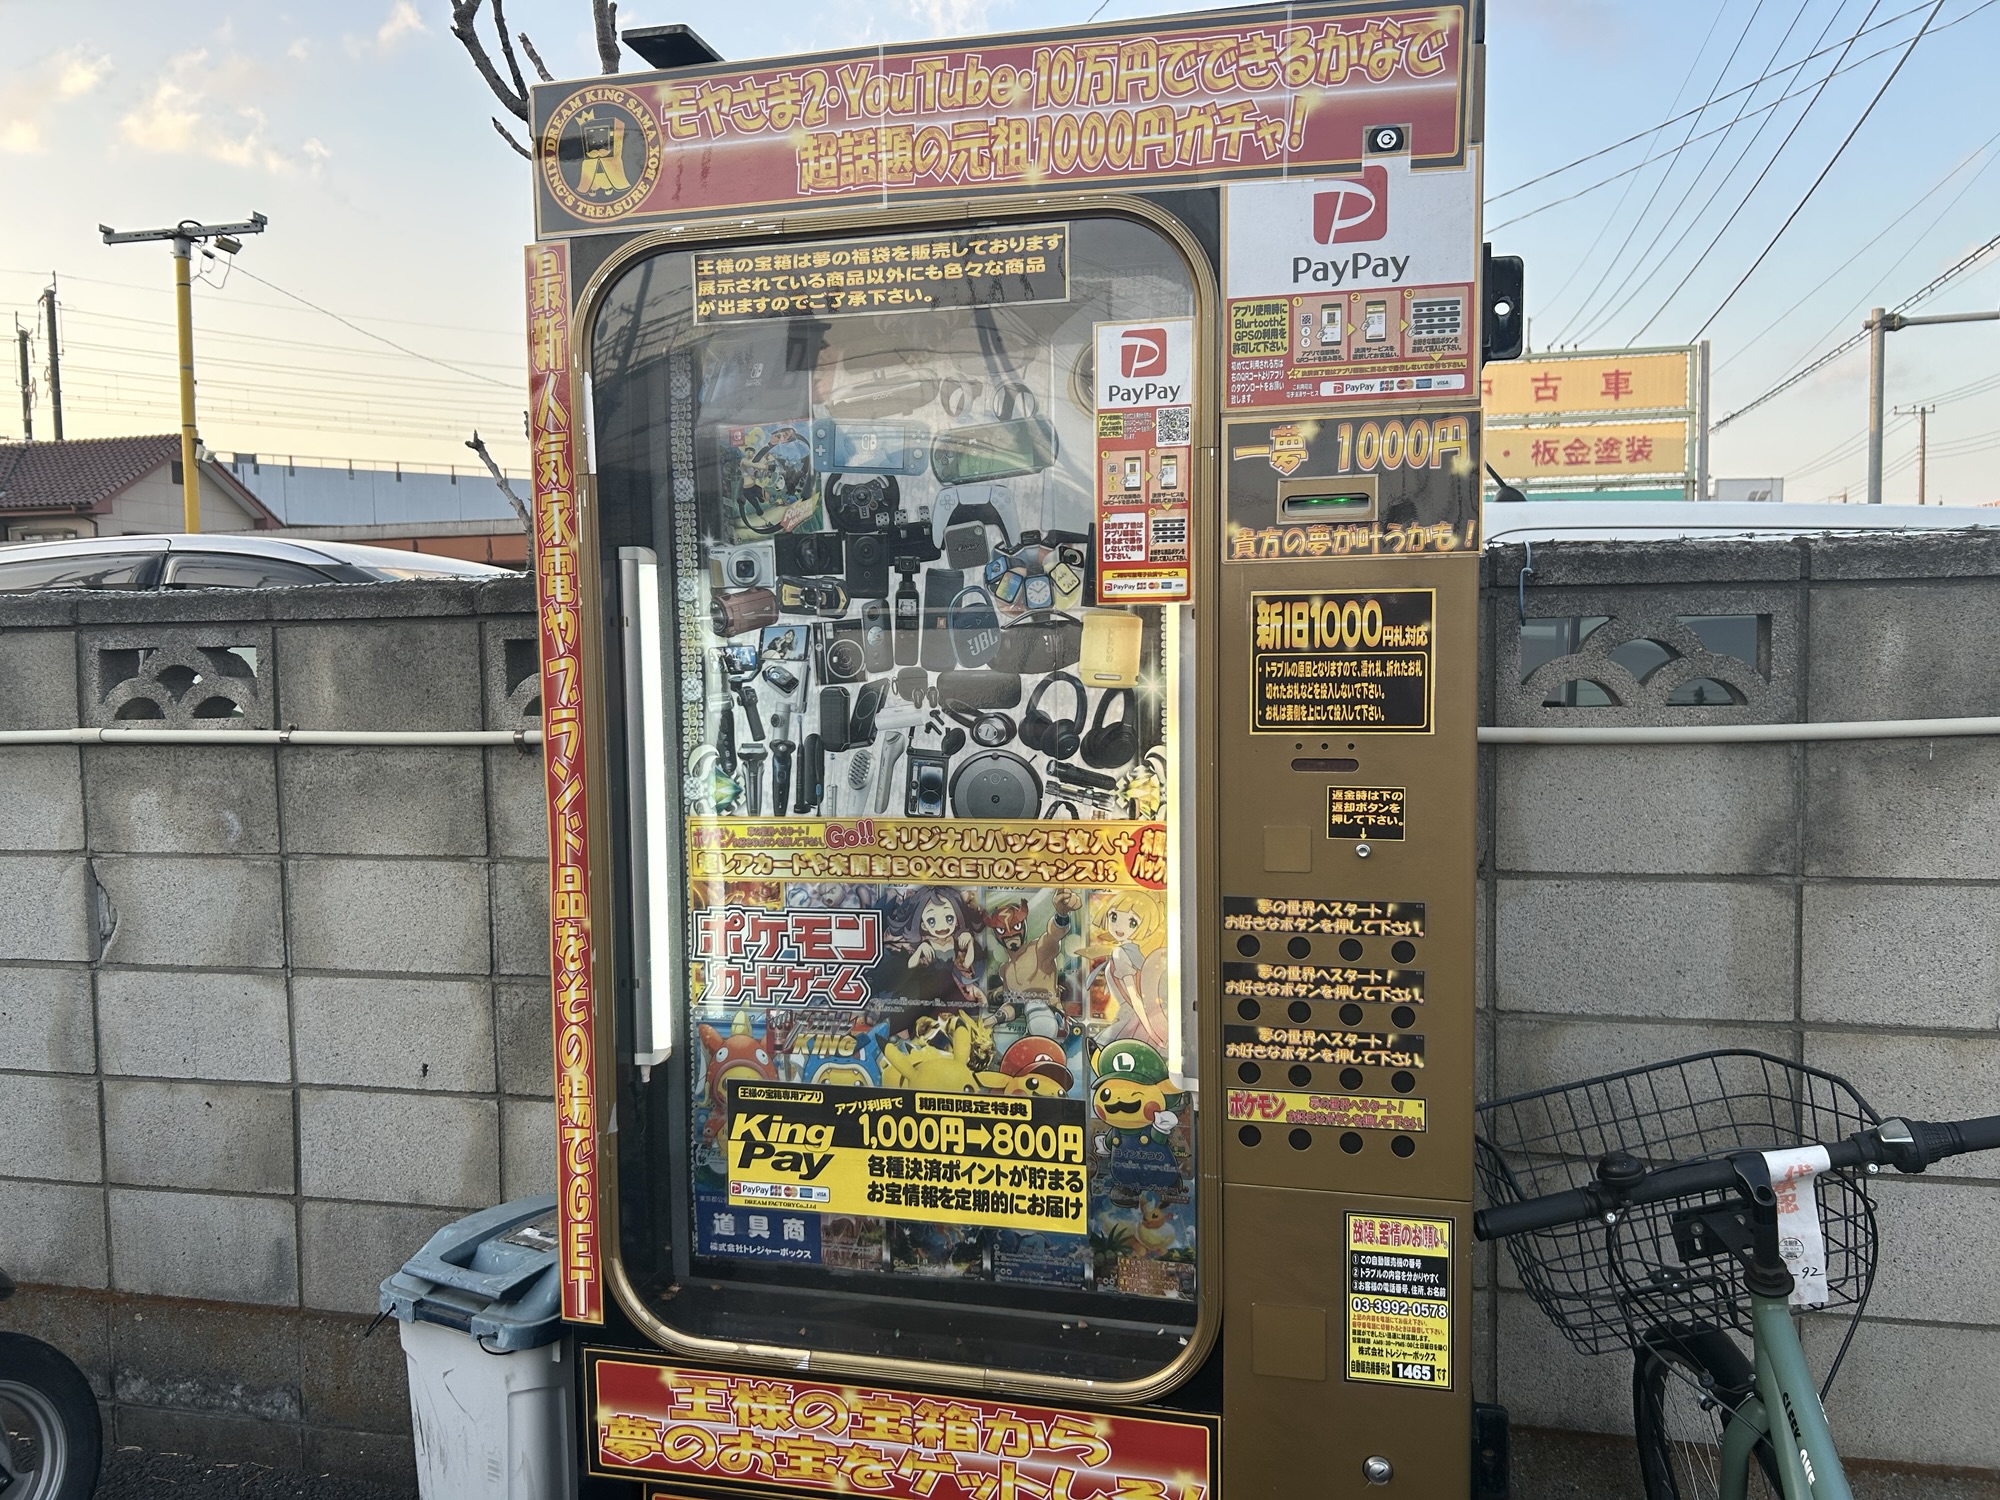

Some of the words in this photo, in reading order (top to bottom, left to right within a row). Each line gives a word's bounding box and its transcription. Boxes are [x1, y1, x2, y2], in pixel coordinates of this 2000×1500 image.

[546, 97, 583, 151] DREAM
[585, 89, 624, 103] KING
[626, 98, 657, 142] SAMA
[546, 156, 575, 206] KING'S
[577, 181, 649, 217] TREASURE
[645, 145, 660, 181] BOX
[697, 233, 1063, 276] 王様の宝箱は夢の福袋を販売しております
[698, 257, 1046, 295] 展示されている商品以外にも色々な商品
[1293, 252, 1410, 286] PayPay
[698, 289, 932, 316] が出ますのでご了承下さい。
[1233, 303, 1288, 317] アプリ使用時に
[1232, 341, 1288, 354] 許可して下さい。
[1234, 328, 1287, 341] GPSの利用を
[1108, 383, 1181, 404] PayPay
[1345, 382, 1376, 393] PayPay
[1233, 424, 1309, 476] 一夢
[1338, 416, 1471, 472] 1000円
[1256, 599, 1429, 650] 新旧1000円札対応
[971, 628, 998, 655] JBL
[1265, 682, 1385, 700] 切れたお札などを投入しないで下さい。
[1331, 802, 1400, 813] 返却ボタンを
[1332, 789, 1404, 801] 返金時は下の
[1331, 814, 1404, 826] 押して下さい。
[825, 819, 875, 849] Go!!
[698, 911, 880, 963] ポケモン
[710, 963, 865, 1001] カードゲーム
[792, 1033, 858, 1057] KING
[740, 1087, 822, 1102] 王様の宝箱専用アプリ
[834, 1097, 903, 1115] アプリ利用で
[918, 1096, 1029, 1118] 期間限定特典
[1228, 1091, 1287, 1120] ポケモン
[730, 1113, 835, 1153] King
[737, 1141, 835, 1180] Pay
[868, 1154, 1084, 1193] 各種決済ポイントが貯まる
[743, 1185, 769, 1196] PayPay
[744, 1199, 767, 1207] DREAM
[768, 1200, 795, 1208] FACTORY
[867, 1181, 1083, 1220] お宝情報を定期的にお届け
[1352, 1218, 1448, 1250] 故障、苦情のお願い。
[709, 1242, 812, 1259] 株式会社トレジャーボックス
[1352, 1296, 1448, 1319] 03-3992-0578
[1396, 1363, 1431, 1380] 1465
[1436, 1368, 1447, 1381] です
[668, 1375, 1113, 1467] 王様の宝箱から
